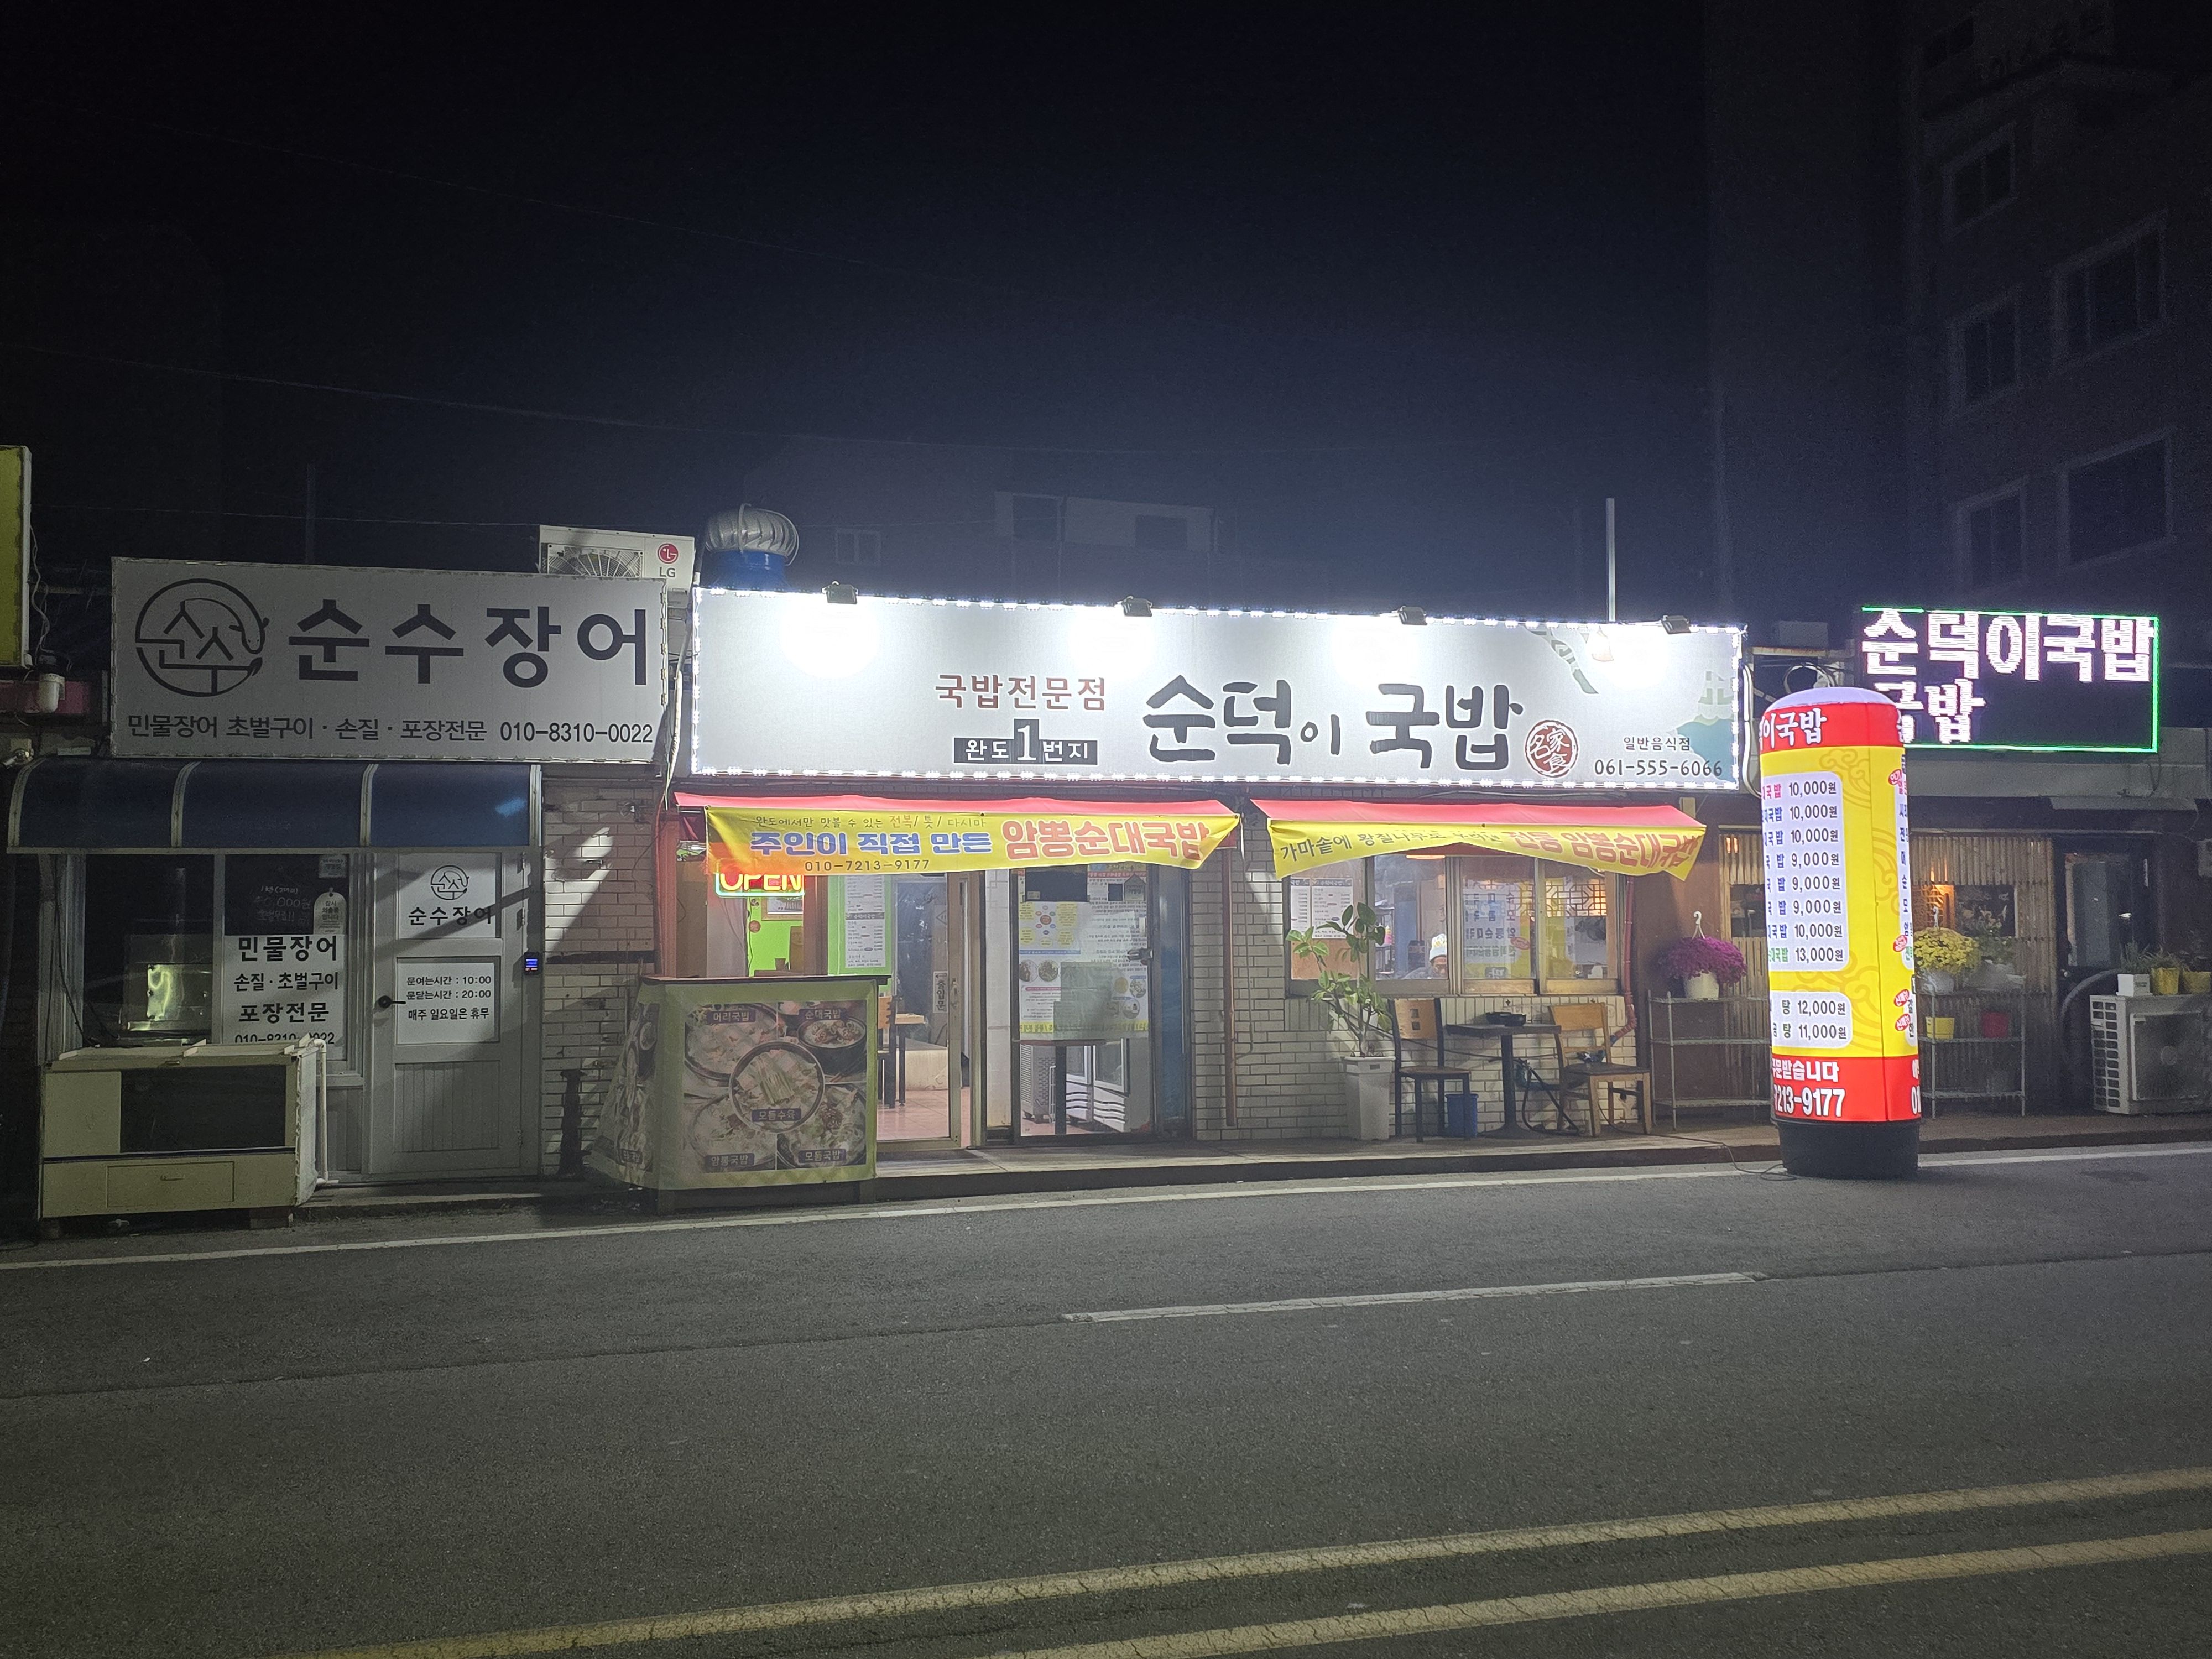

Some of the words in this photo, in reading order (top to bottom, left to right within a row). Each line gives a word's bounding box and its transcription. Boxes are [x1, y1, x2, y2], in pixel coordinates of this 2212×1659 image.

[659, 567, 676, 578] LG
[289, 599, 646, 687] 순수장어
[1862, 608, 2155, 682] 순덕이국밥
[935, 674, 1105, 710] 국밥전문점
[128, 715, 217, 738] 민물장어
[226, 716, 314, 740] 초벌구이
[335, 718, 379, 742] 손질
[401, 718, 487, 743] 포장전문
[500, 721, 653, 744] 010-8310-0022
[1142, 675, 1340, 766] 순덕이
[1365, 682, 1522, 769] 국밥
[1624, 736, 1691, 751] 일반음식점
[1595, 759, 1723, 776] 061-555-6066
[1789, 780, 1837, 797] 10,000원
[1790, 804, 1837, 821] 10,000원
[755, 816, 813, 828] 완도에서만
[820, 817, 841, 828] 맛볼
[848, 818, 856, 827] 수
[863, 818, 883, 828] 있는
[947, 818, 986, 828] 다시마
[749, 831, 847, 855] 주인이
[857, 832, 920, 854] 직접
[931, 832, 992, 854] 만든
[1003, 820, 1207, 861] 암뽕순대국밥
[1791, 828, 1838, 844] 10,000원
[1281, 834, 1352, 862] 가마솥에
[805, 859, 930, 872] 010-7213-9177
[1791, 852, 1839, 869] 9,000원
[1792, 875, 1840, 892] 9,000원
[408, 906, 491, 926] 순수장어
[1793, 899, 1841, 916] 9,000원
[1794, 924, 1843, 940] 10,000원
[238, 936, 337, 962] 민물장어
[1796, 947, 1844, 963] 13,000원
[234, 973, 264, 992] 손질
[278, 972, 338, 990] 초벌구이
[406, 977, 452, 985] 문여는시간
[462, 976, 491, 984] 10:00
[406, 990, 452, 999] 문닫는시간
[462, 990, 491, 998] 20:00
[238, 1003, 329, 1024] 포장전문
[408, 1009, 427, 1021] 매주
[430, 1008, 468, 1020] 일요일은
[471, 1008, 489, 1019] 휴무
[713, 1011, 749, 1022] 머리국밥
[805, 1009, 841, 1020] 순대국밥
[1798, 1000, 1845, 1016] 12,000원
[1799, 1024, 1846, 1040] 11,000원
